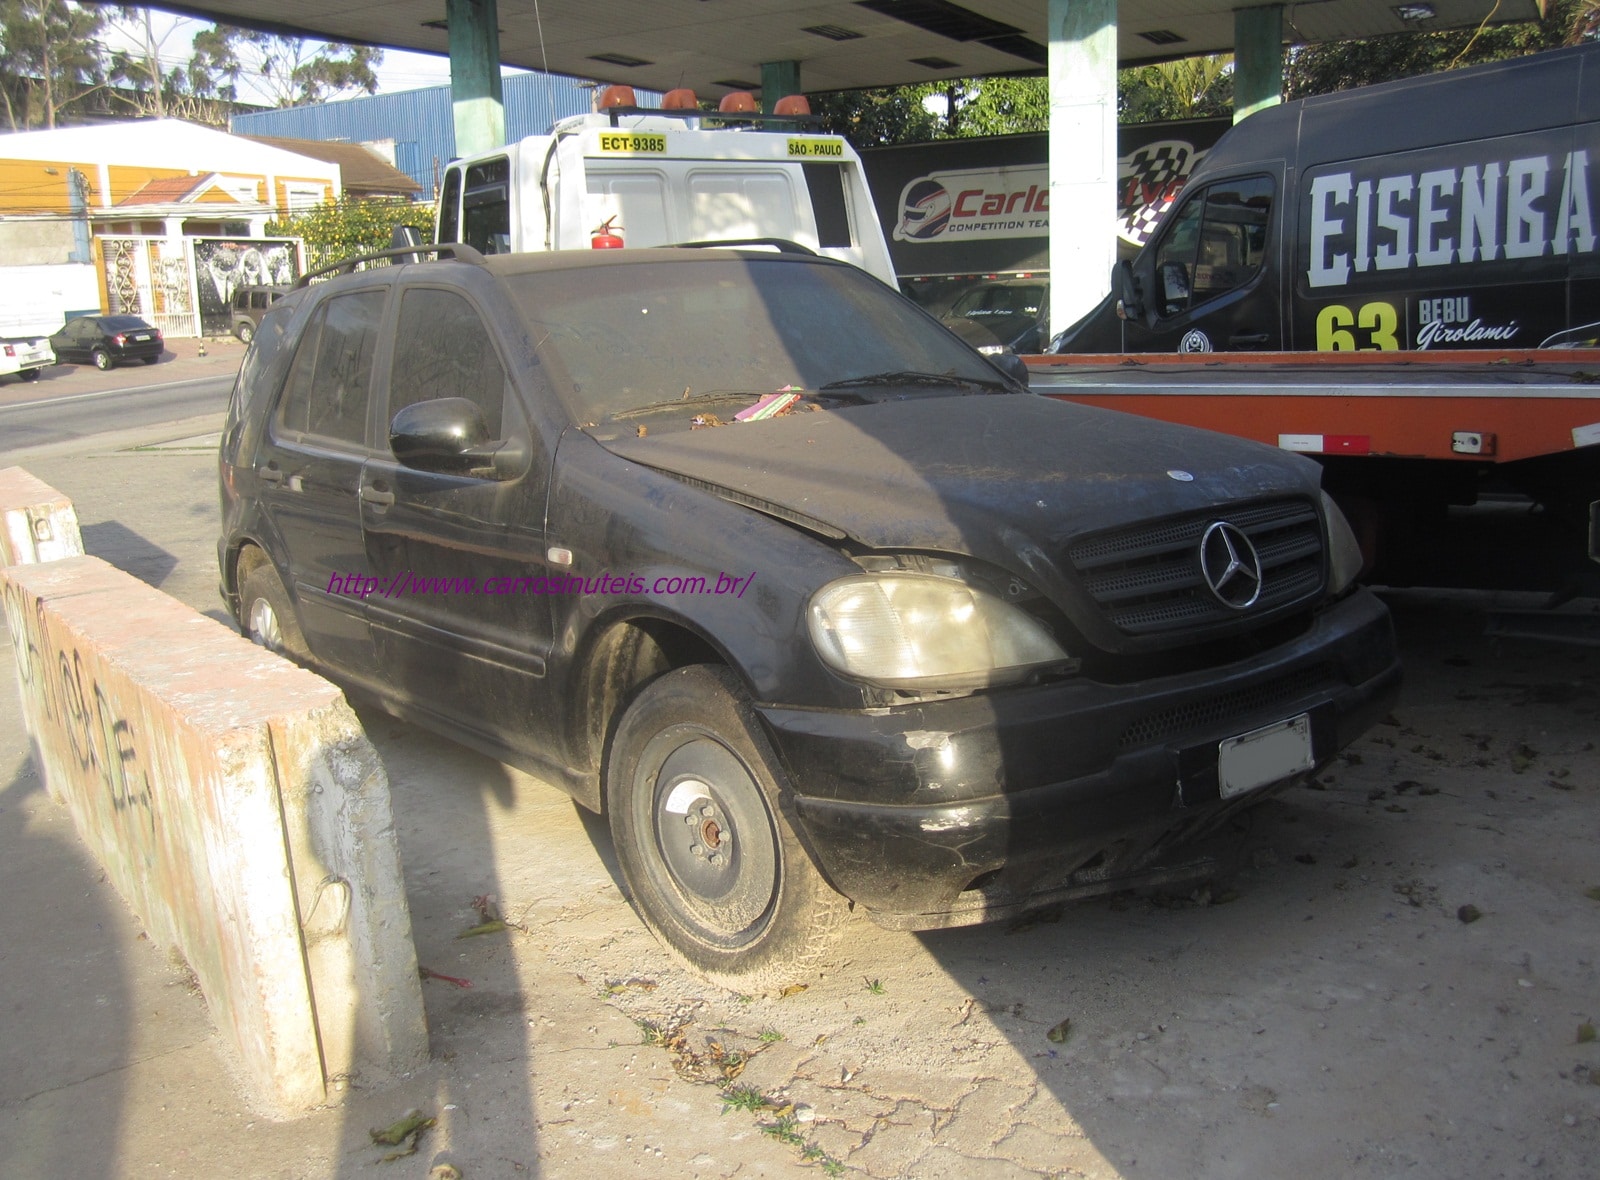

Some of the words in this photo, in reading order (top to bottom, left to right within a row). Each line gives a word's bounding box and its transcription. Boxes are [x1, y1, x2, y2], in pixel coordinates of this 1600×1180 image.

[601, 137, 664, 151] ECT-9385
[814, 144, 842, 155] PAULO
[948, 221, 1024, 232] COMPETITION
[1419, 297, 1469, 324] BEBU
[1316, 302, 1398, 352] 63
[1416, 319, 1518, 351] Girolami
